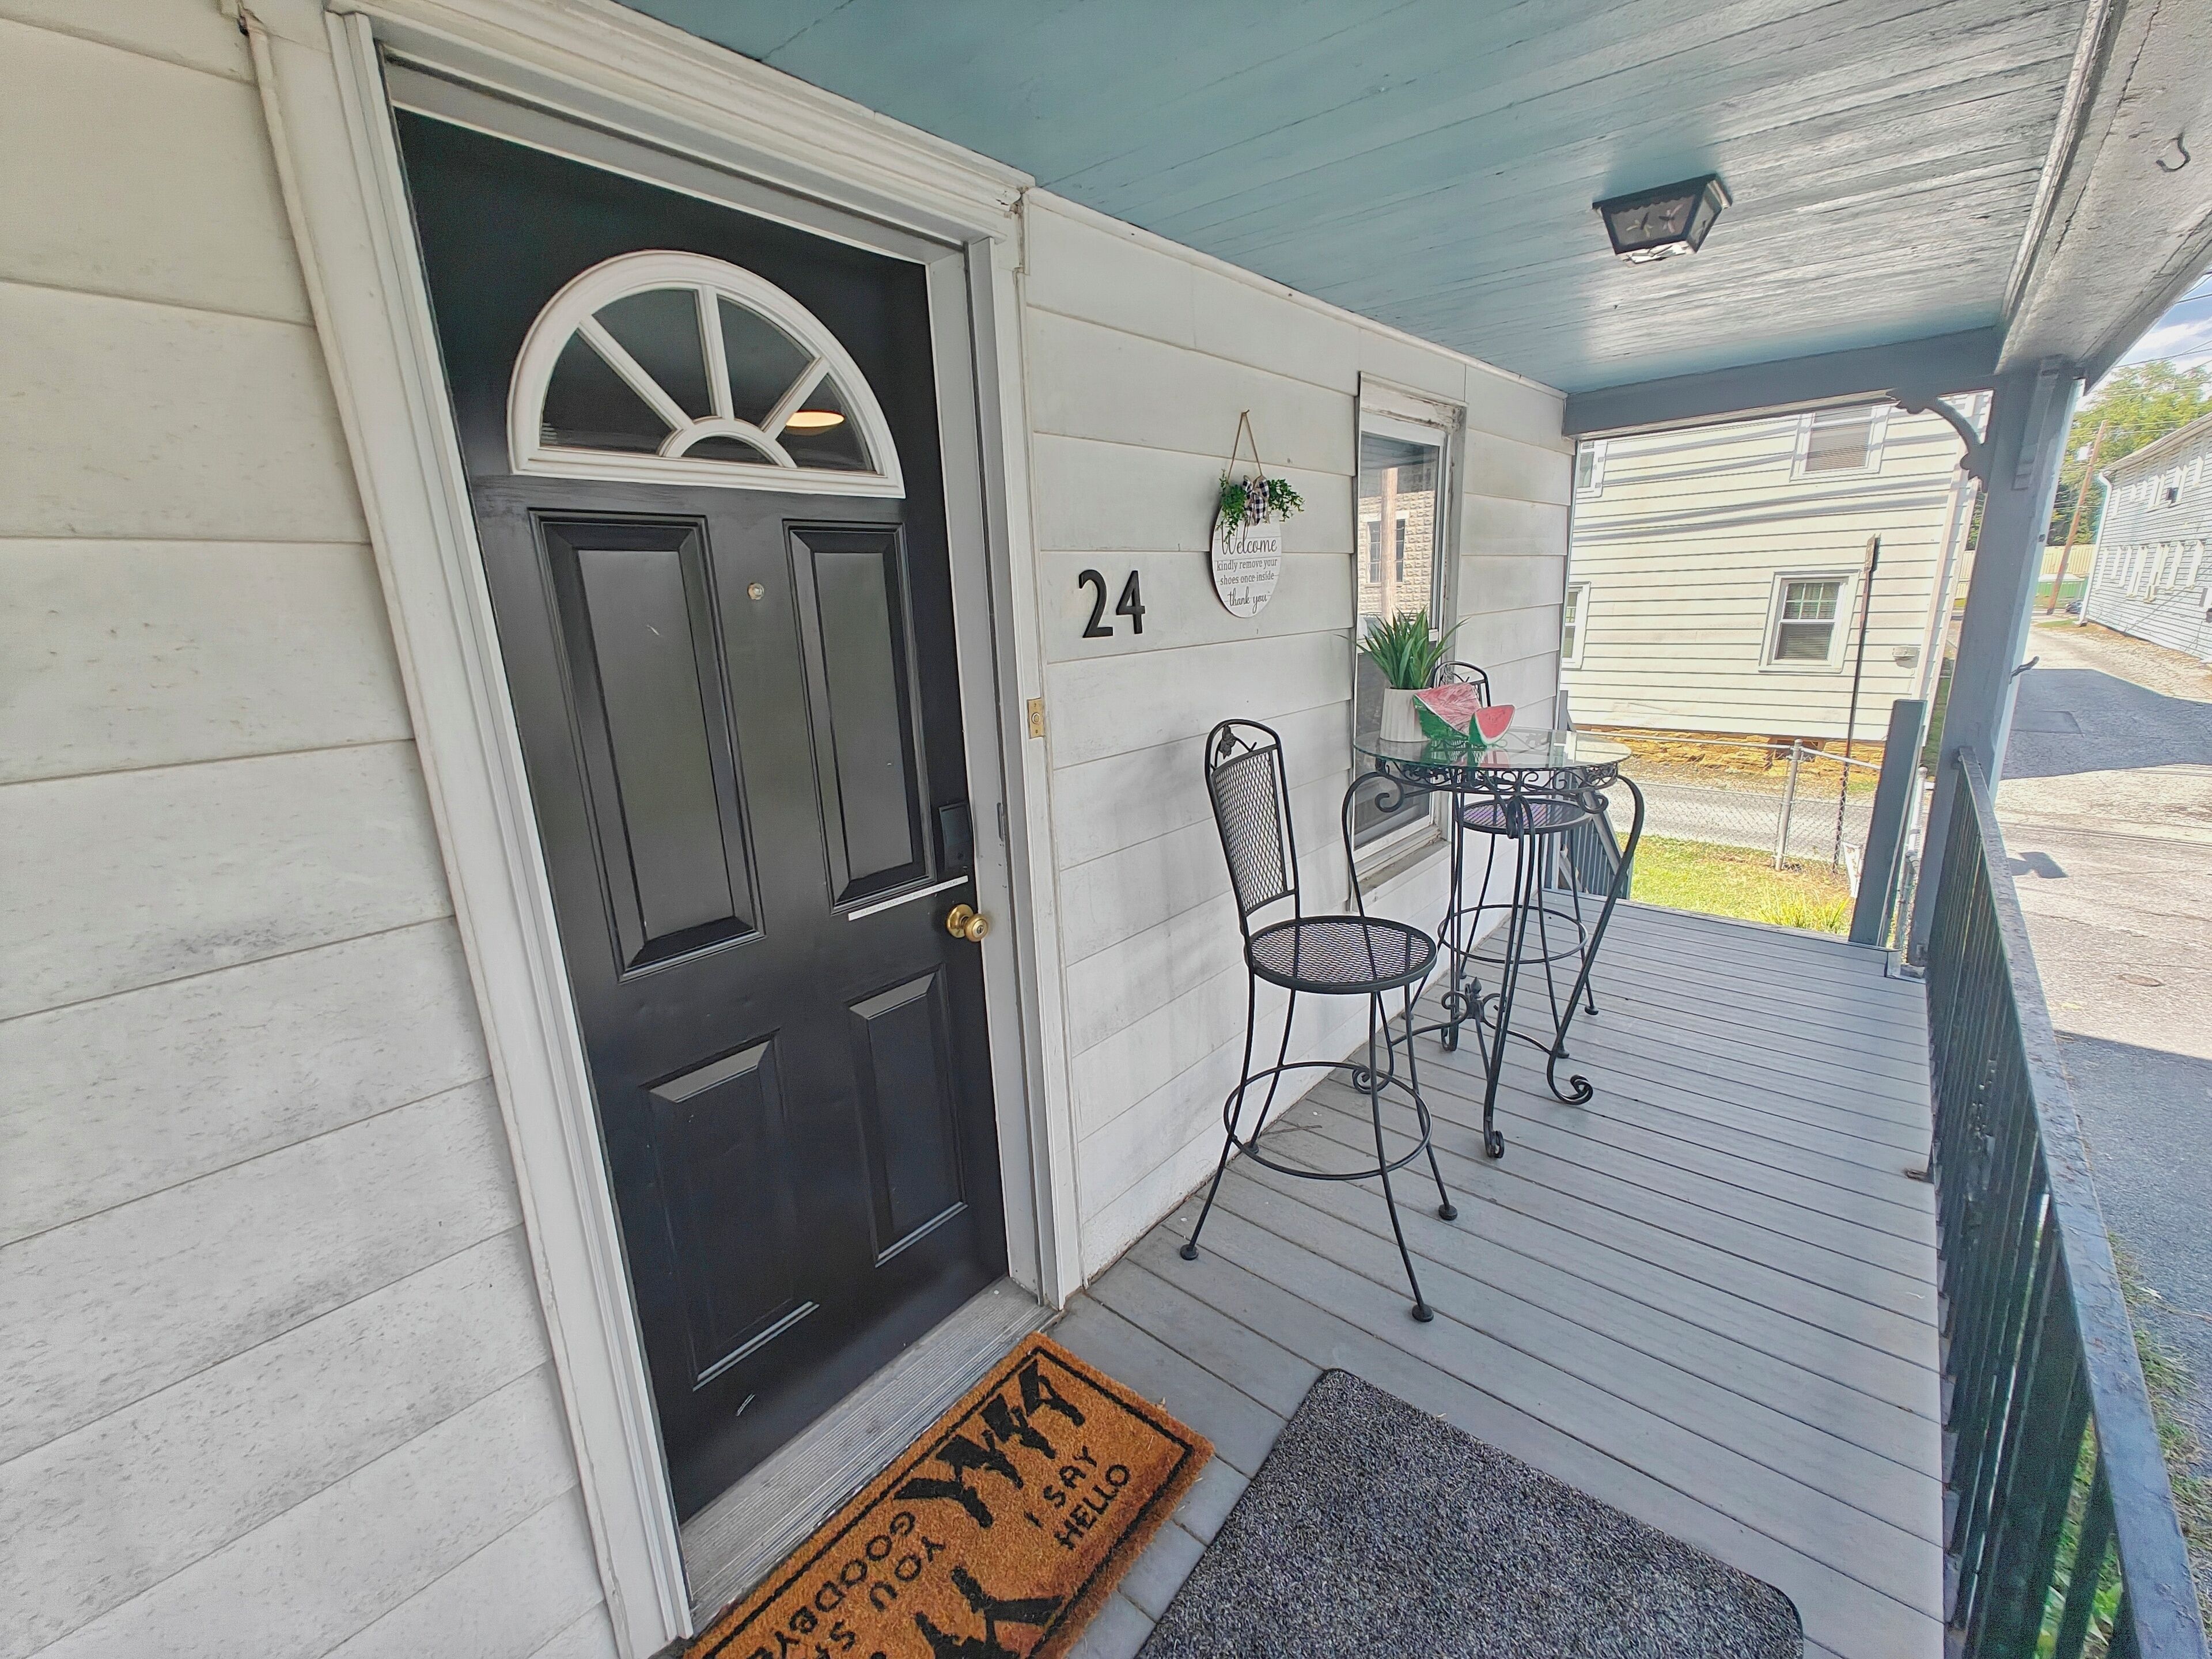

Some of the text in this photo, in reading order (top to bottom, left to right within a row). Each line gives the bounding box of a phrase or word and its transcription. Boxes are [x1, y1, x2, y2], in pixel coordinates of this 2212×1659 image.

[1221, 520, 1277, 555] Welcome
[1217, 559, 1278, 572] kindly remove your
[1220, 571, 1275, 585] shoes once inside
[1078, 569, 1146, 638] 24
[1227, 586, 1267, 614] thank you
[1024, 1445, 1097, 1528] I SAY
[1054, 1464, 1131, 1551] HELLO
[870, 1536, 945, 1612] YOU
